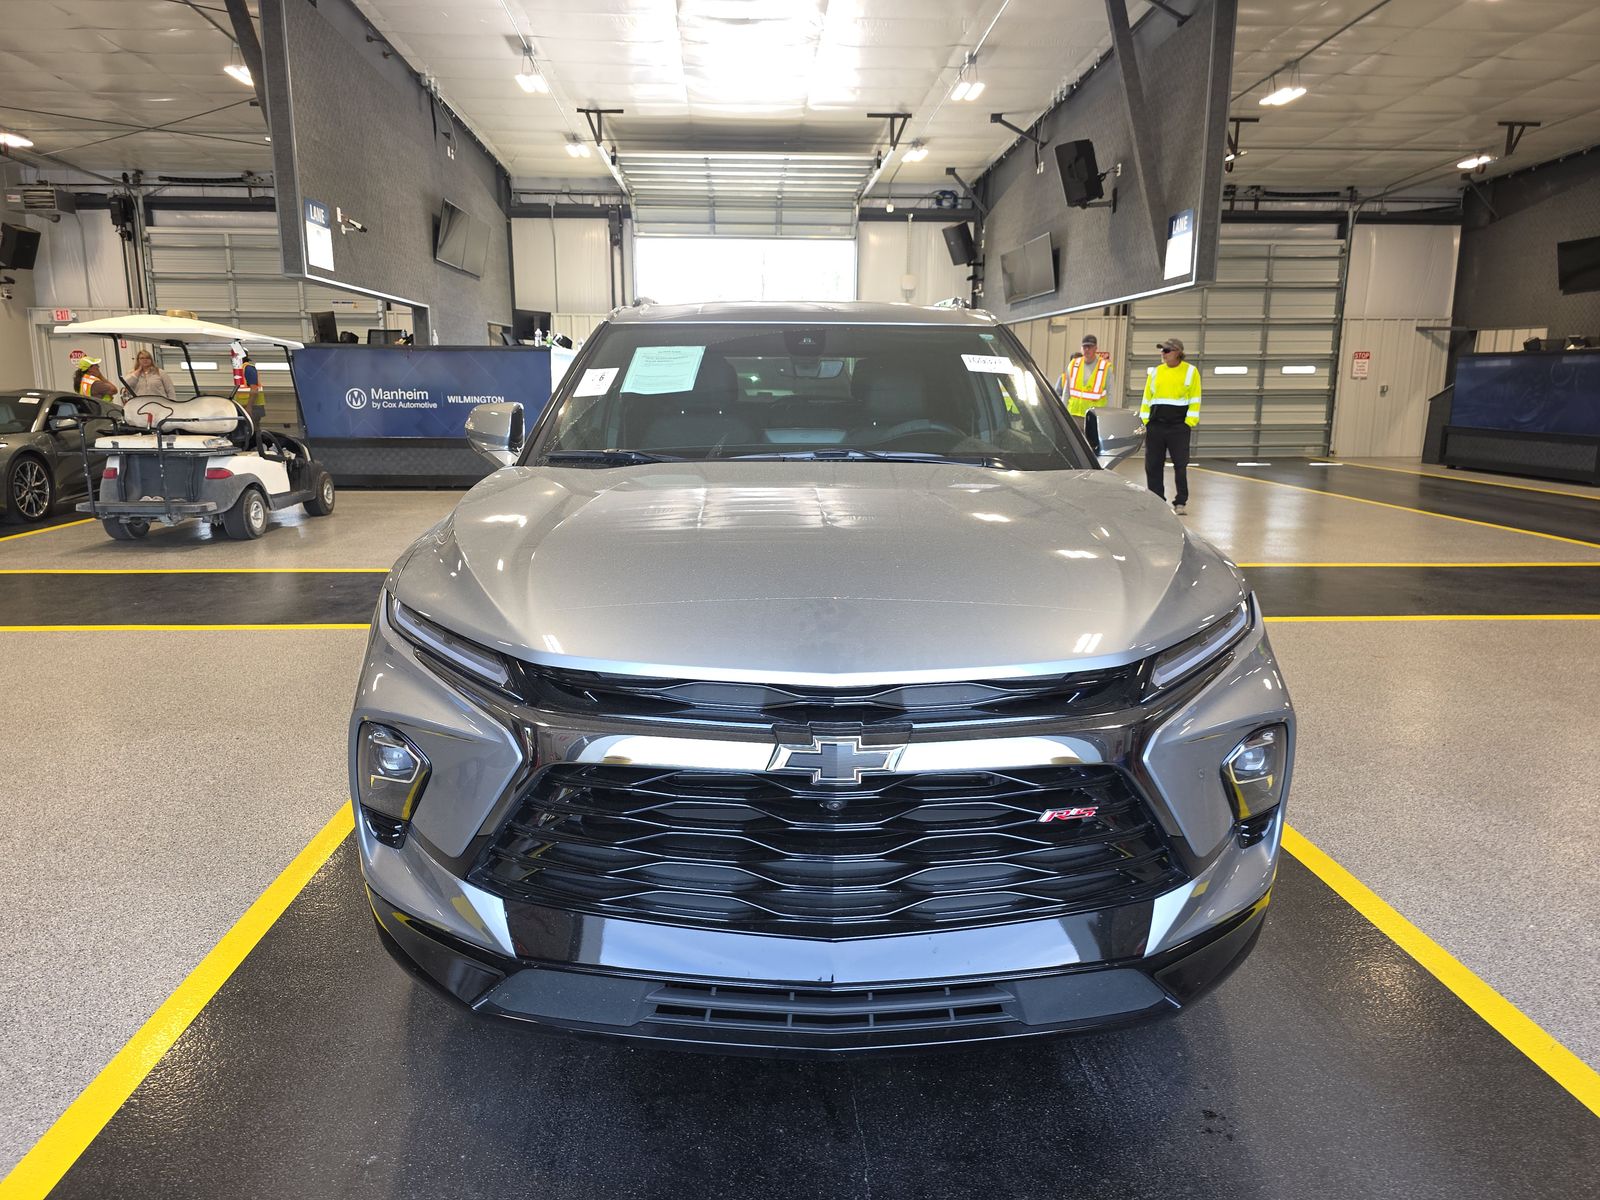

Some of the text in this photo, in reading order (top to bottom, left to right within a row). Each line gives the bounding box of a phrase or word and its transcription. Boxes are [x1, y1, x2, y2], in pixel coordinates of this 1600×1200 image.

[309, 203, 326, 224] LANE
[1172, 215, 1188, 235] LANE
[55, 310, 70, 320] EXIT
[370, 388, 429, 400] Manheim
[446, 395, 505, 404] WILMINGTON
[371, 401, 438, 410] by Cox Automotive
[1036, 806, 1099, 823] RS
